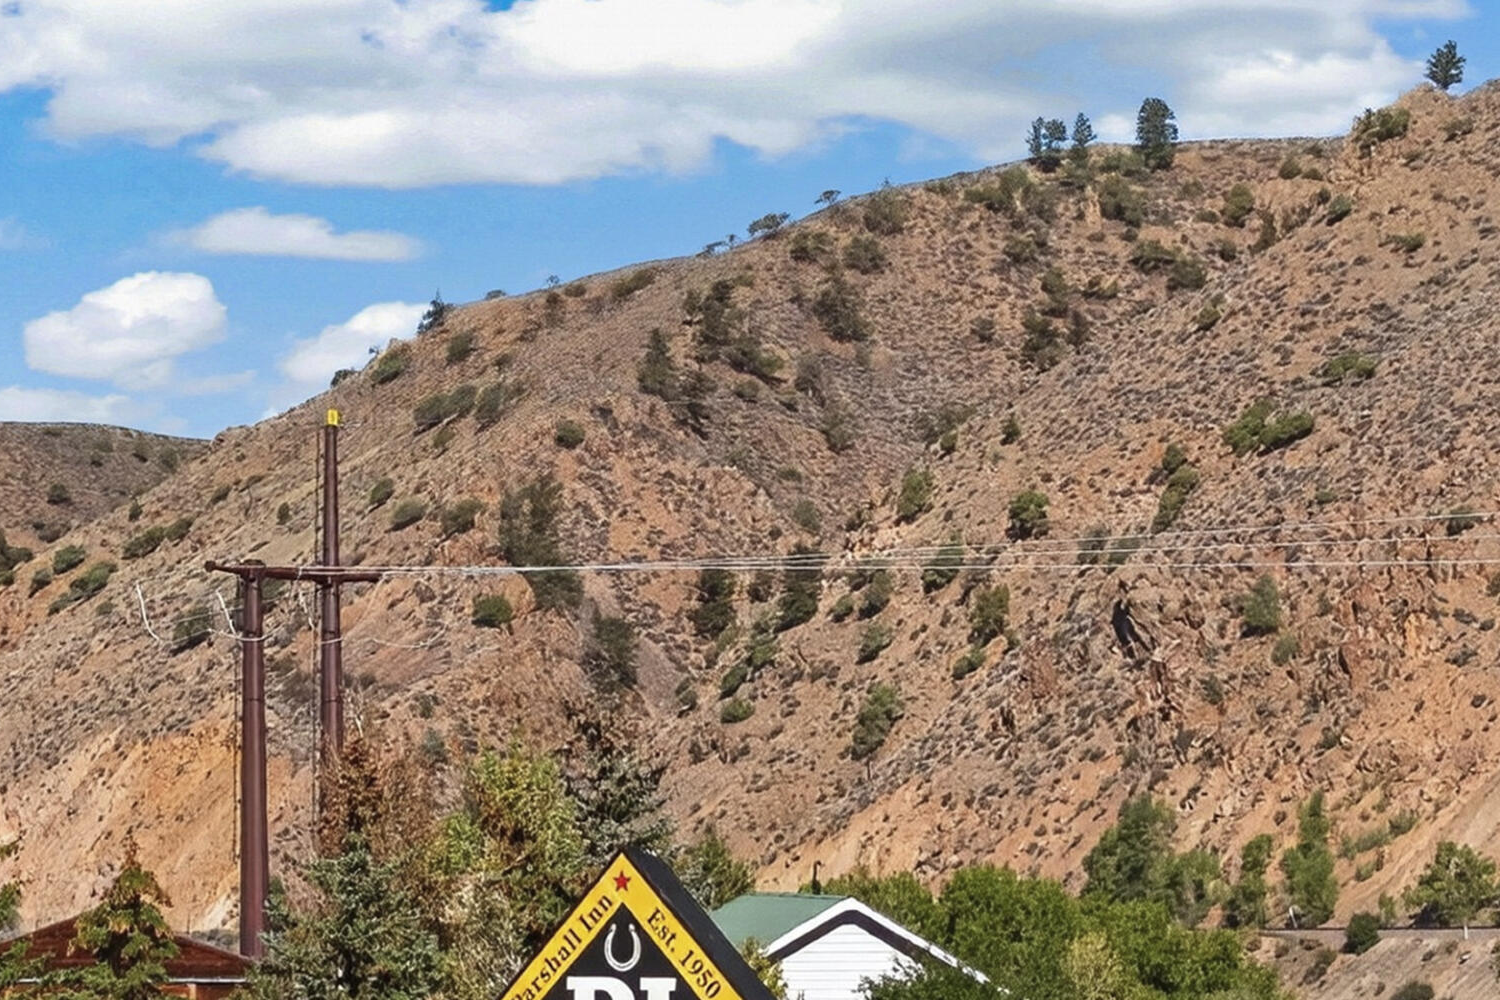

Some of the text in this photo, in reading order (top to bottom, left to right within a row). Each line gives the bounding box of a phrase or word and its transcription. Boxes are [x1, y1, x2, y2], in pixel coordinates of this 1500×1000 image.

[583, 895, 614, 932] Inn
[647, 908, 721, 1000] Est. 1950
